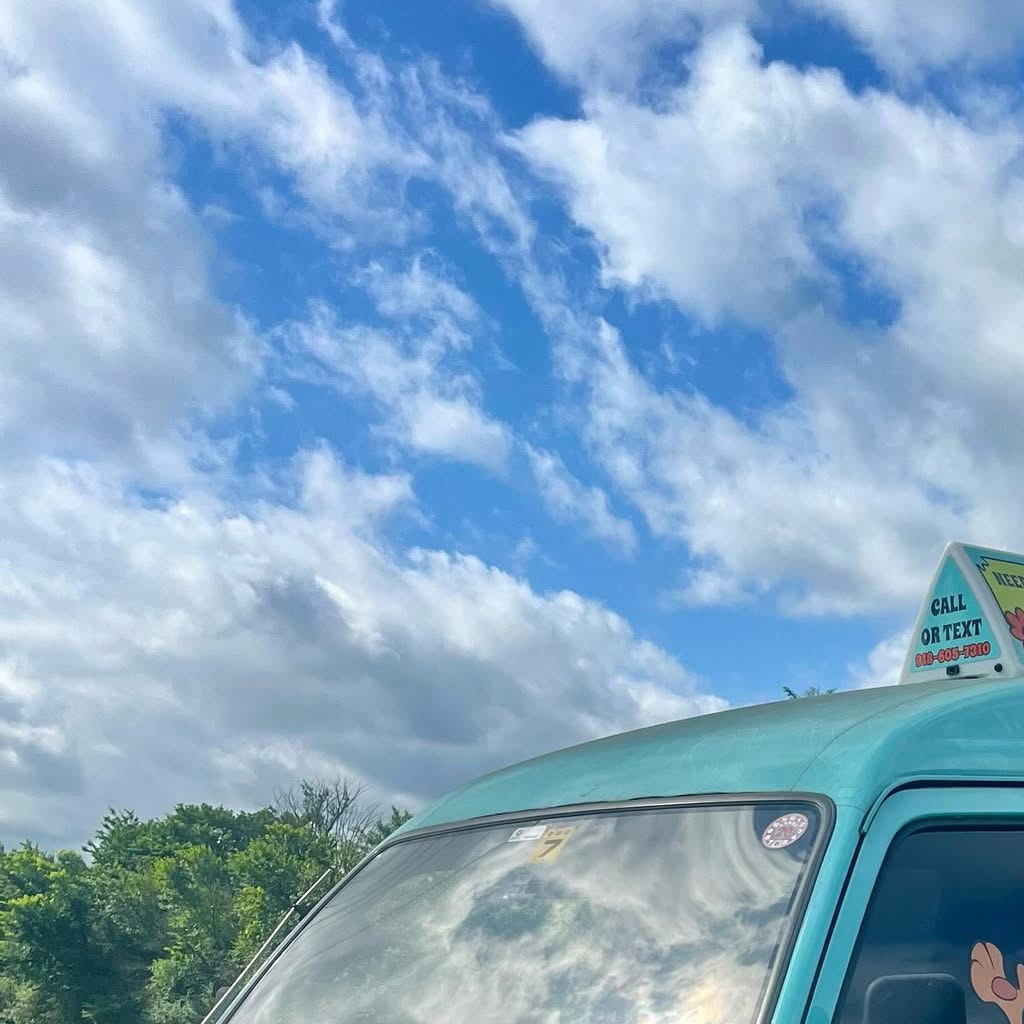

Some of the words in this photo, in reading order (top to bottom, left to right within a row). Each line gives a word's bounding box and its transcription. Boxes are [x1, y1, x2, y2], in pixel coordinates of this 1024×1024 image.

[931, 594, 967, 616] CALL
[921, 626, 941, 646] OR
[942, 618, 983, 641] TEXT
